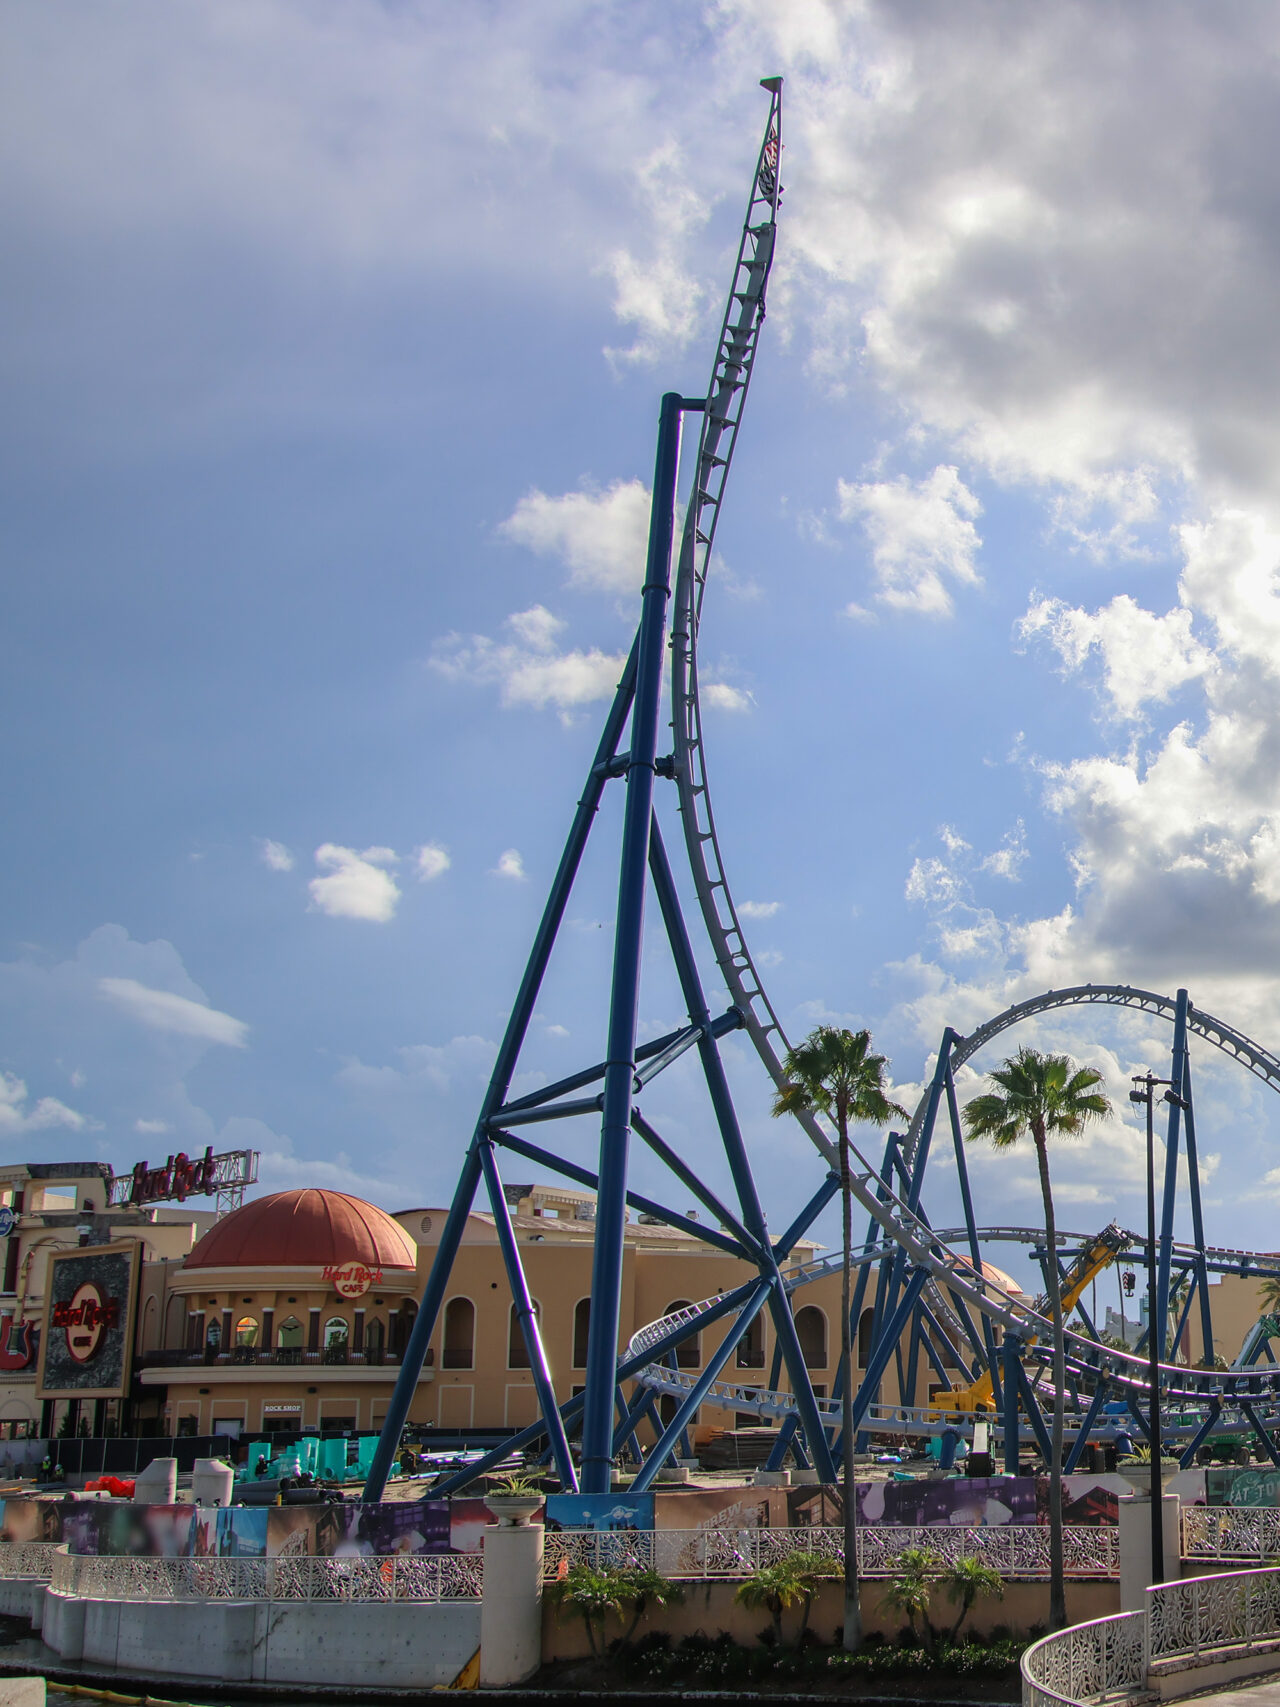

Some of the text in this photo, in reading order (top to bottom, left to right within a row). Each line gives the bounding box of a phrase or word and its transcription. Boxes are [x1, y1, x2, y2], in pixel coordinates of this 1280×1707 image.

[131, 1155, 174, 1207] Hard
[321, 1266, 383, 1285] Hard Rock
[342, 1284, 364, 1293] CAFE
